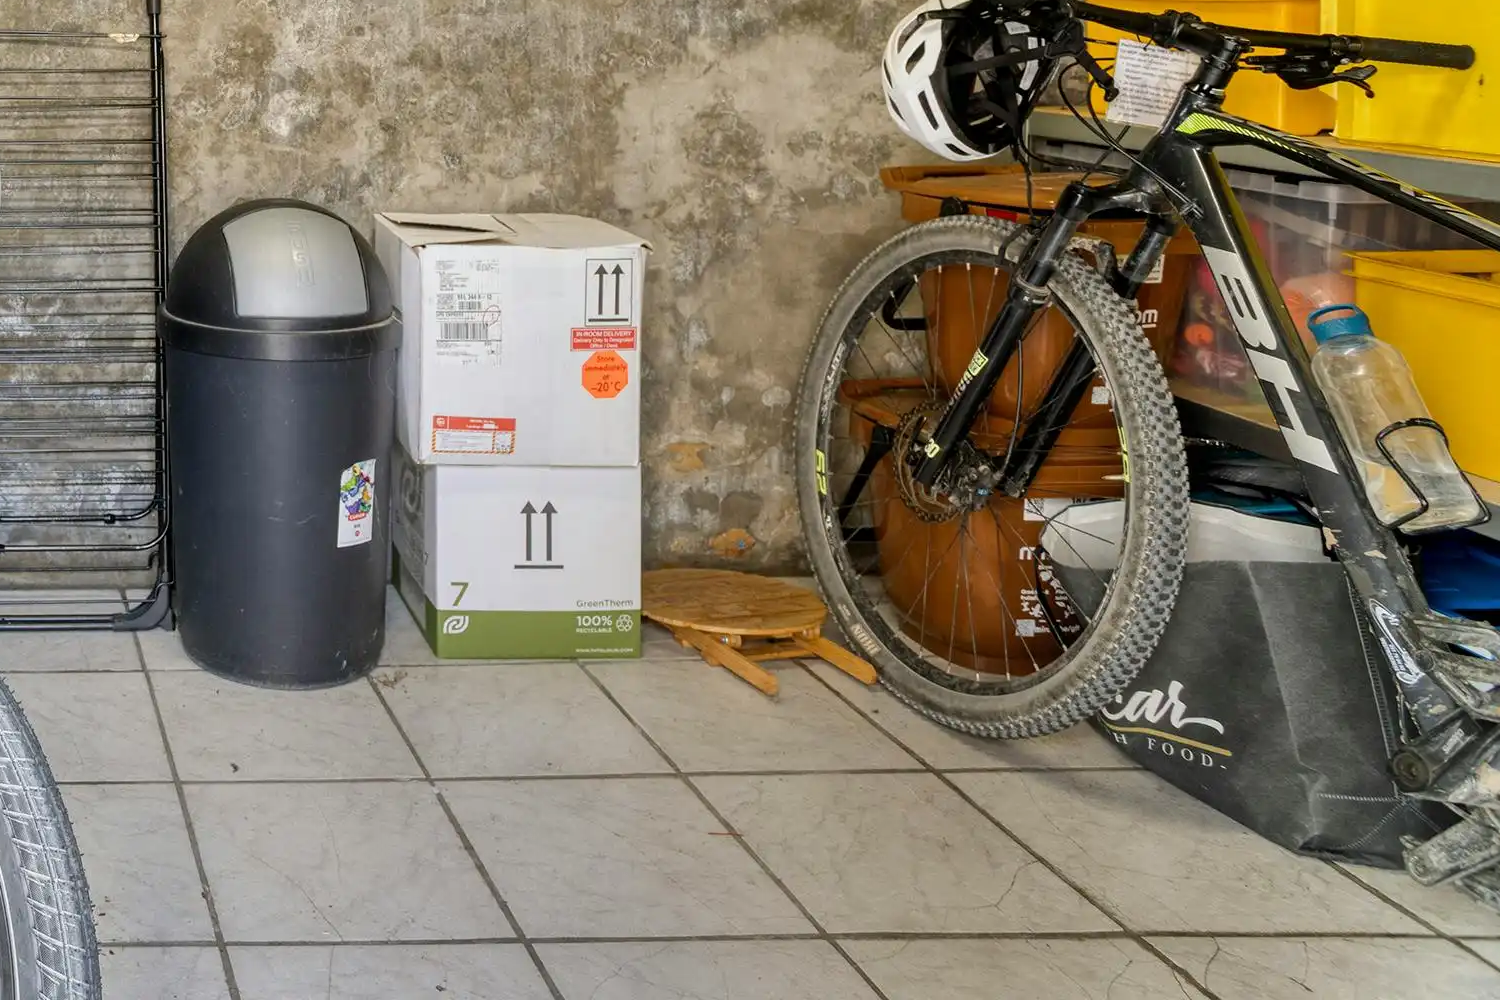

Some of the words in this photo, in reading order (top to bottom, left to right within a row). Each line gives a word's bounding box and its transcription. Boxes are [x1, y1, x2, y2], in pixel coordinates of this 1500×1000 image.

[1201, 244, 1339, 475] BH
[450, 582, 469, 607] 7
[576, 600, 634, 609] GreenTherm
[576, 615, 613, 627] 100%
